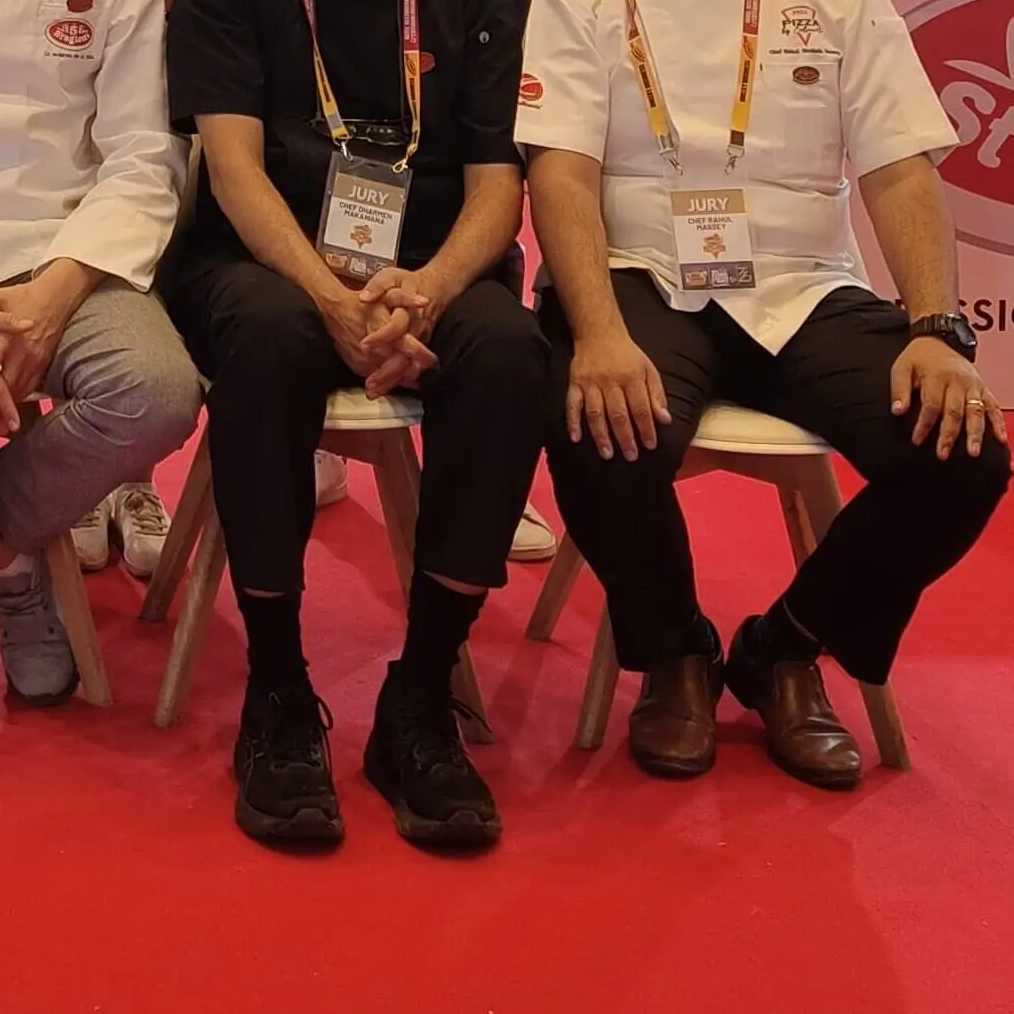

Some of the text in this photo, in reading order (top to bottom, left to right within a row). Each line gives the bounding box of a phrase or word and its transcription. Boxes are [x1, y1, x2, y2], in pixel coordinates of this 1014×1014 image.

[348, 185, 390, 206] JURY
[339, 202, 357, 212] CHEF
[687, 197, 729, 212] JURY
[687, 217, 706, 225] CHEF
